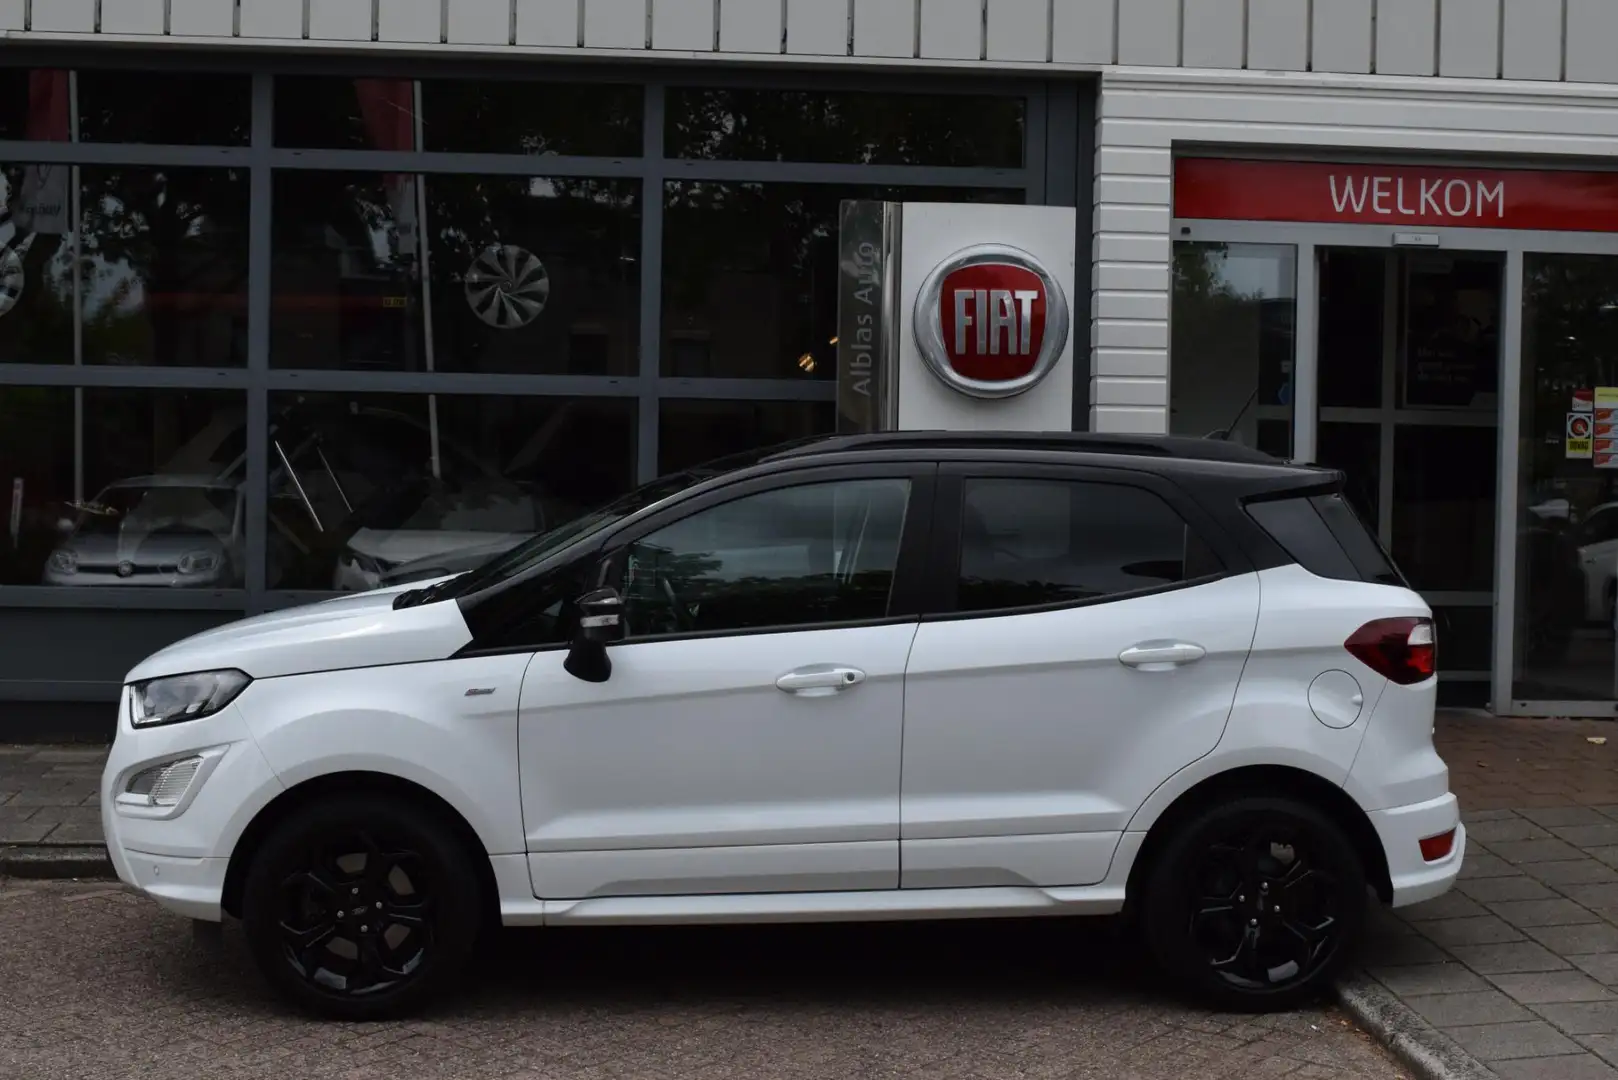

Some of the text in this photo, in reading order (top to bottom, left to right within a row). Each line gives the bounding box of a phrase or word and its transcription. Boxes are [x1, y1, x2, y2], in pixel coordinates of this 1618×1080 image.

[1329, 175, 1504, 218] WELKOM
[850, 242, 875, 397] Alblas Auto
[954, 289, 1039, 355] FIAT
